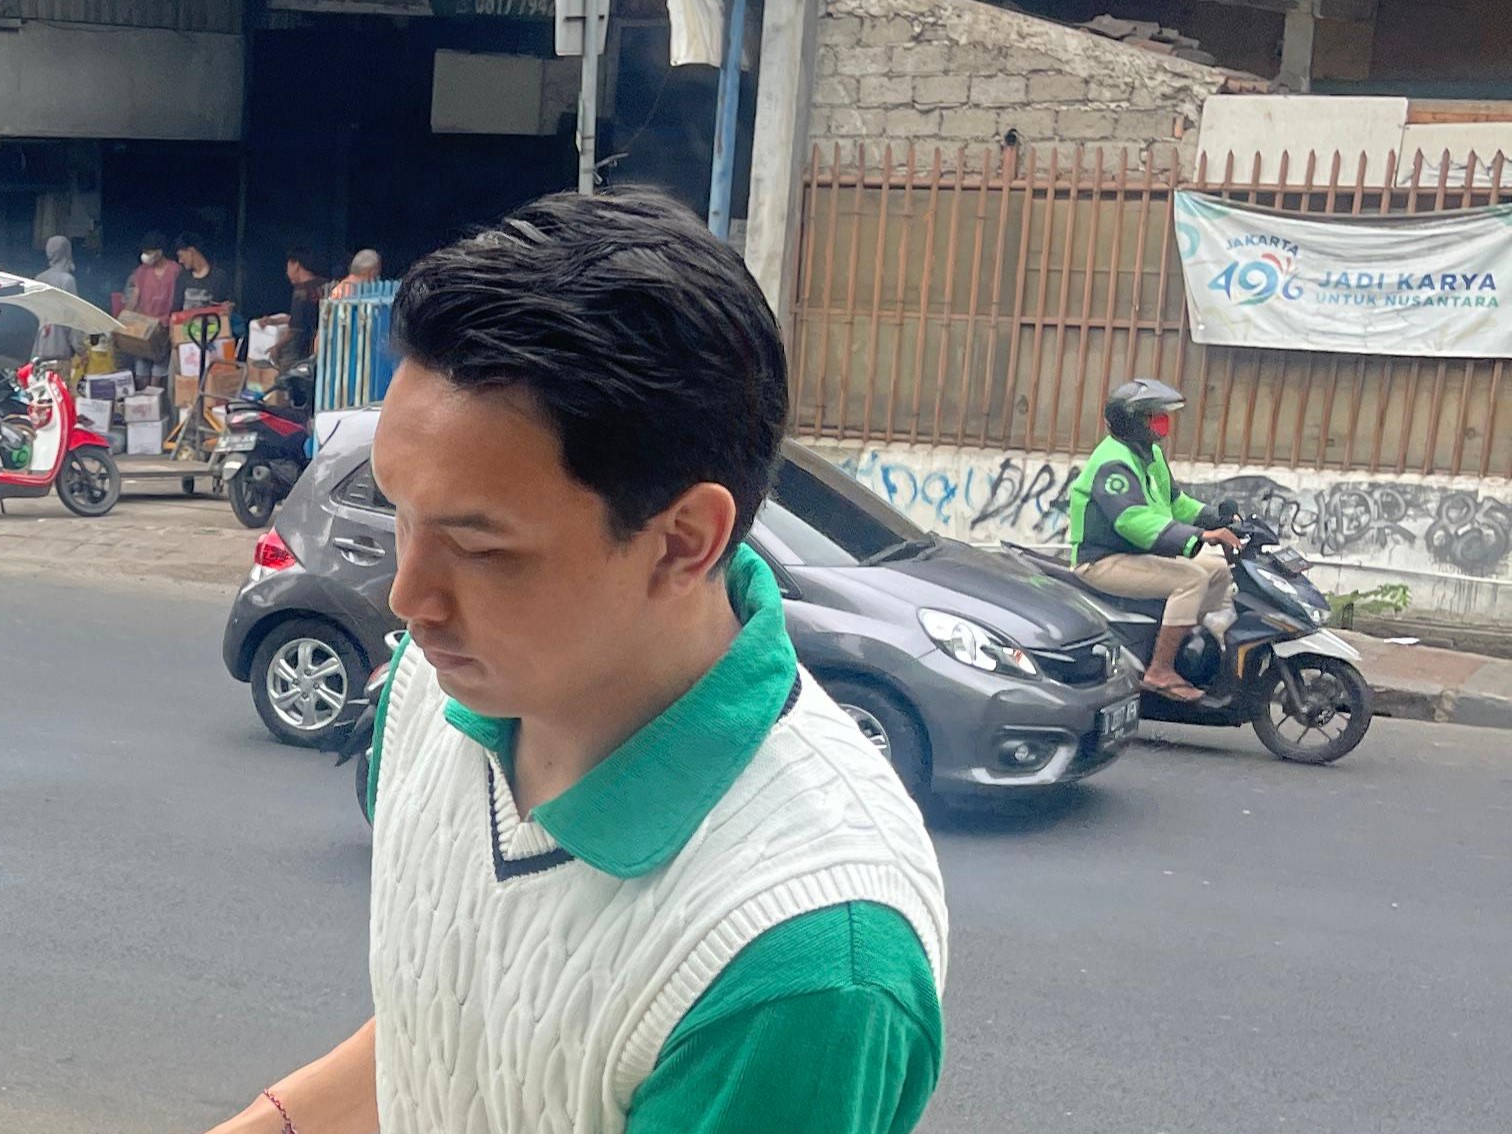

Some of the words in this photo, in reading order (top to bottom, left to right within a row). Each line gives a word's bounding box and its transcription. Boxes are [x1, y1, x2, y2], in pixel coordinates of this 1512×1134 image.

[1226, 234, 1300, 257] JAKARTA
[1317, 271, 1385, 290] JADI
[1398, 273, 1497, 292] KARYA
[1316, 293, 1377, 307] UNTUK
[1388, 293, 1500, 309] NUSANTARA
